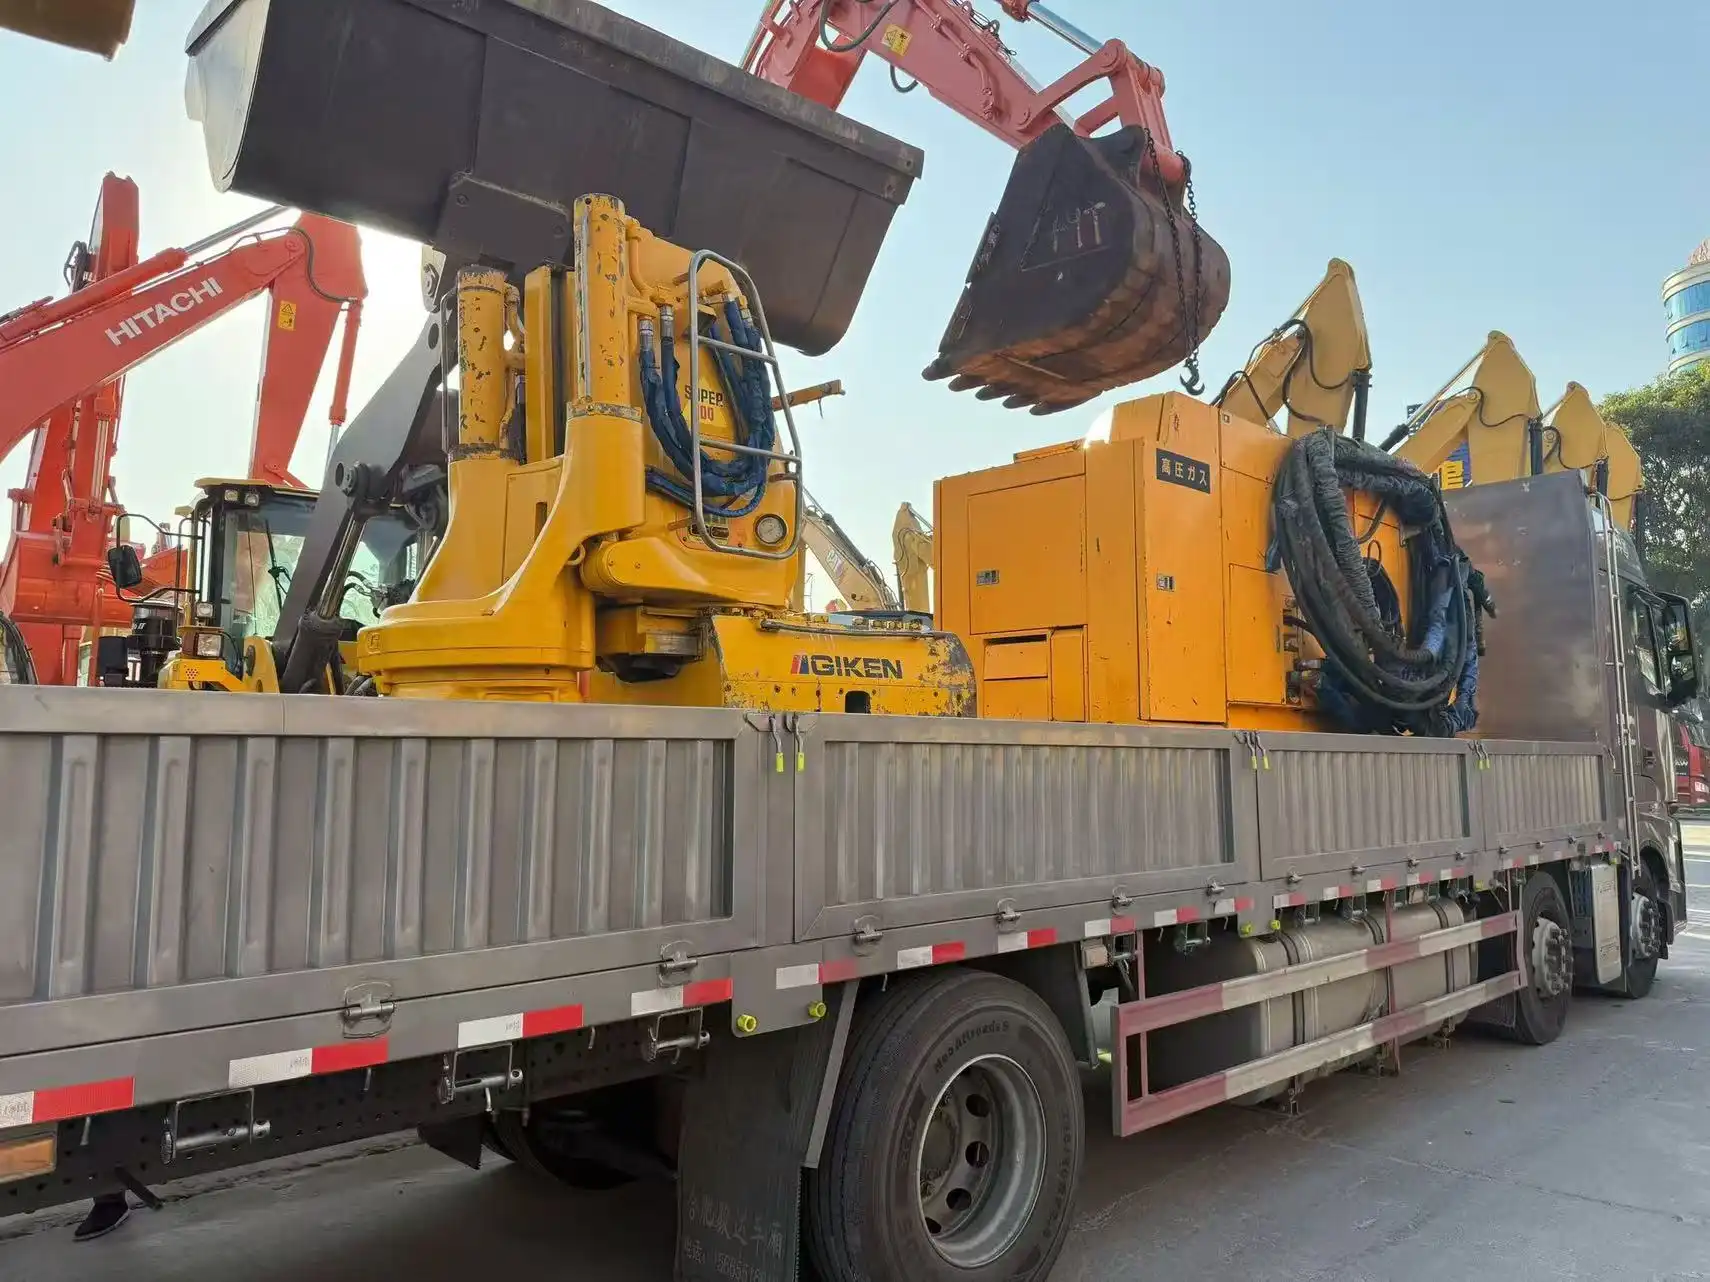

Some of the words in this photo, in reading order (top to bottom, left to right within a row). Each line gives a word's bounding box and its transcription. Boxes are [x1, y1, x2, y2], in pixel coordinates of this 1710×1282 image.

[104, 276, 223, 347] HITACHI
[684, 384, 724, 407] SPER
[1161, 457, 1207, 486] 高圧ガス
[810, 654, 903, 680] GIKEN
